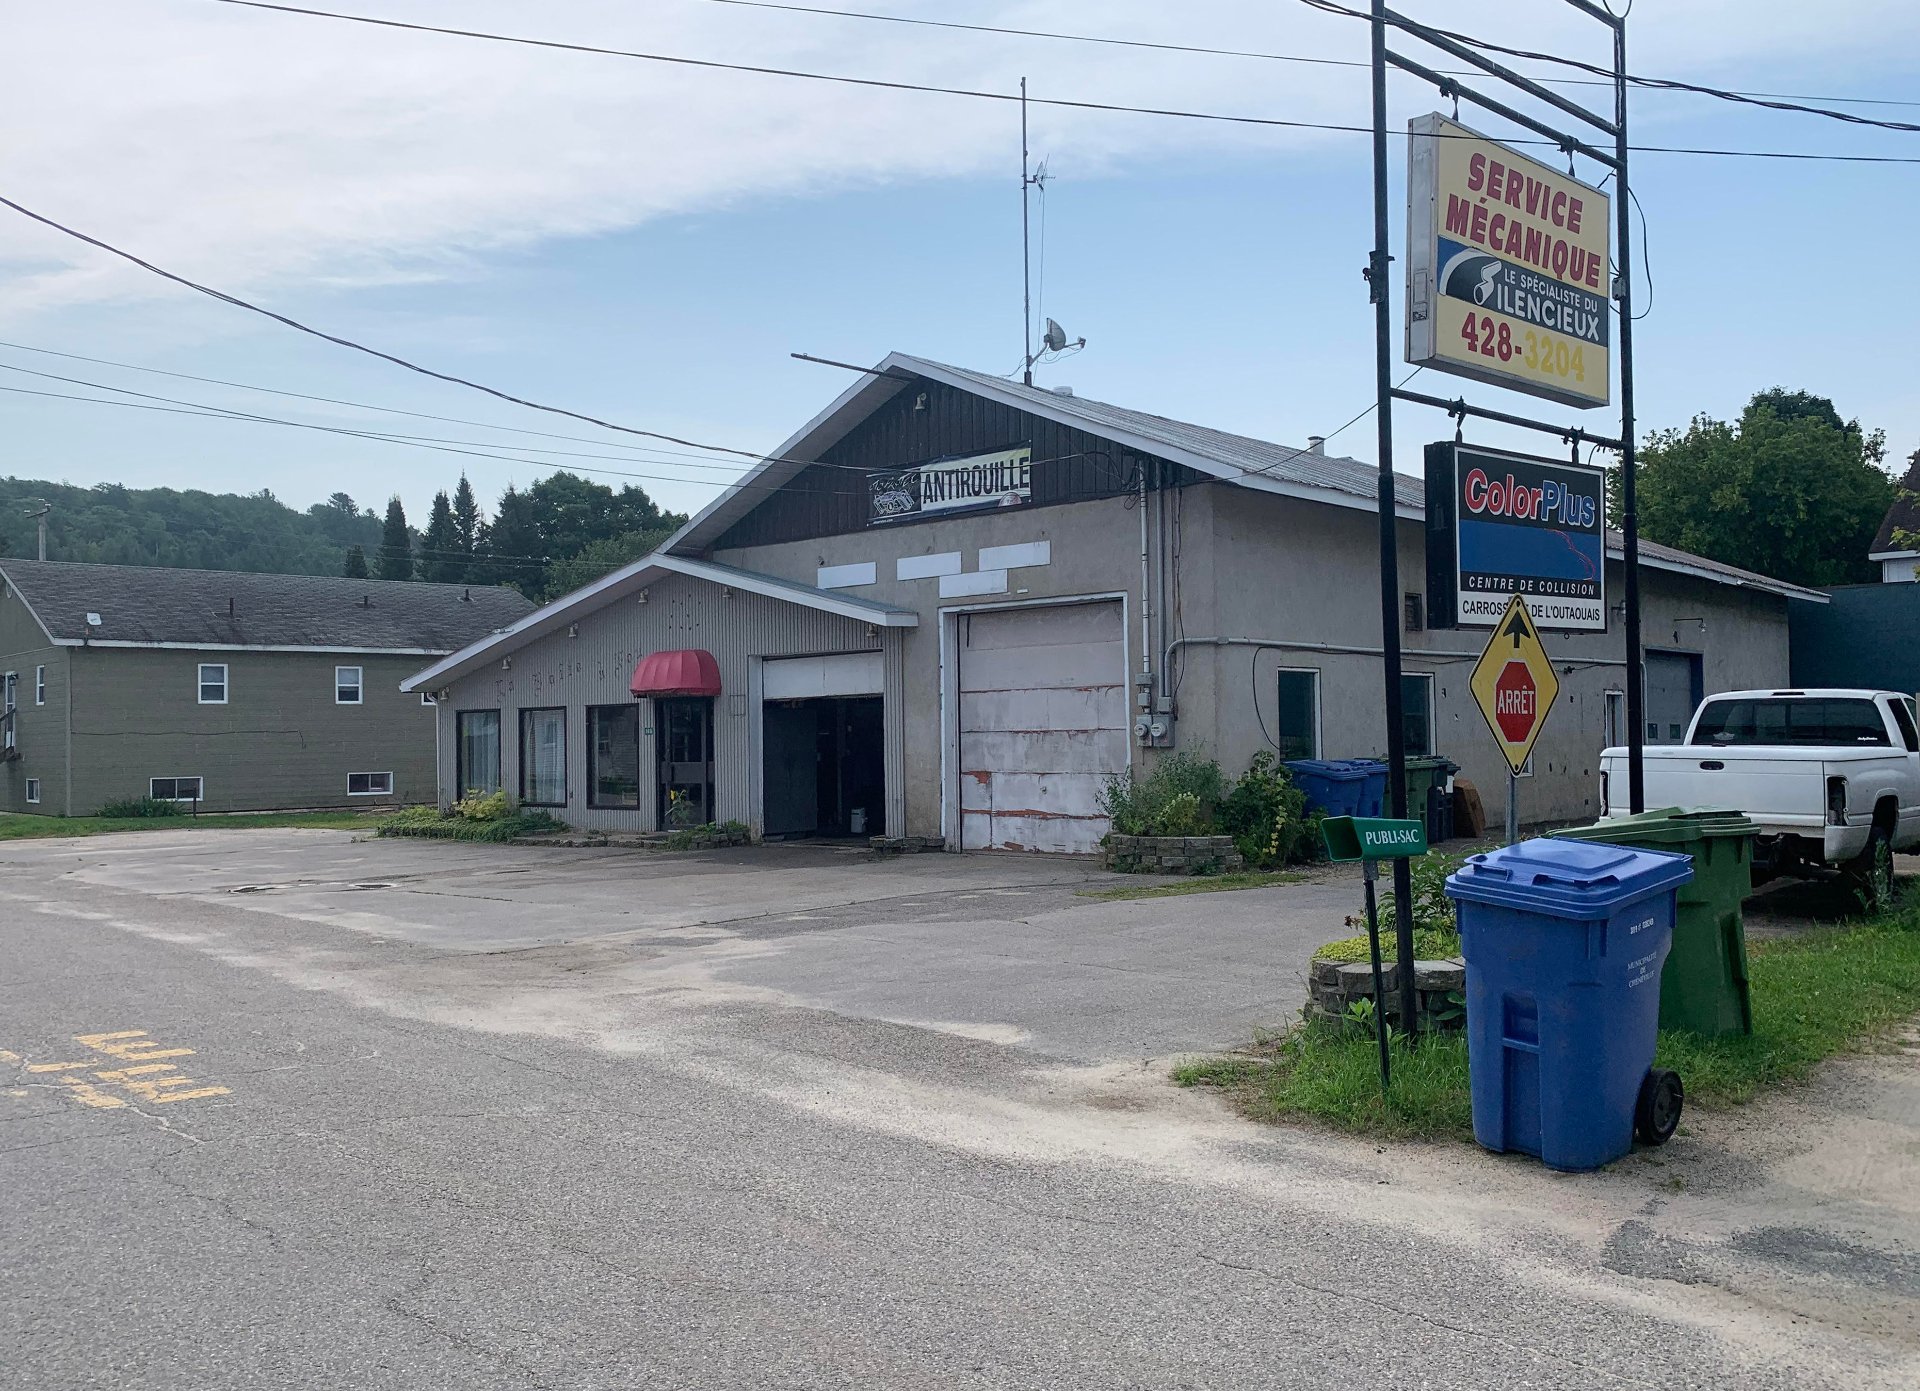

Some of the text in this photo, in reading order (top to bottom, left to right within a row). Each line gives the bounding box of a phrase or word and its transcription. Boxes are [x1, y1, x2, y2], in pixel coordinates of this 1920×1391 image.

[1468, 152, 1584, 235] SERVICE
[1445, 193, 1601, 289] MÉCANIQUE
[1504, 268, 1598, 313] LE SPÉCIALISTE DU
[1461, 311, 1585, 383] 428-3204
[923, 456, 1030, 504] ANTIROUILLE
[1468, 575, 1595, 596] CENTRE DE COLLISION
[1531, 604, 1544, 618] DE
[1545, 606, 1600, 622] L'OUTAOUAIS
[1497, 685, 1534, 715] ARRÊT
